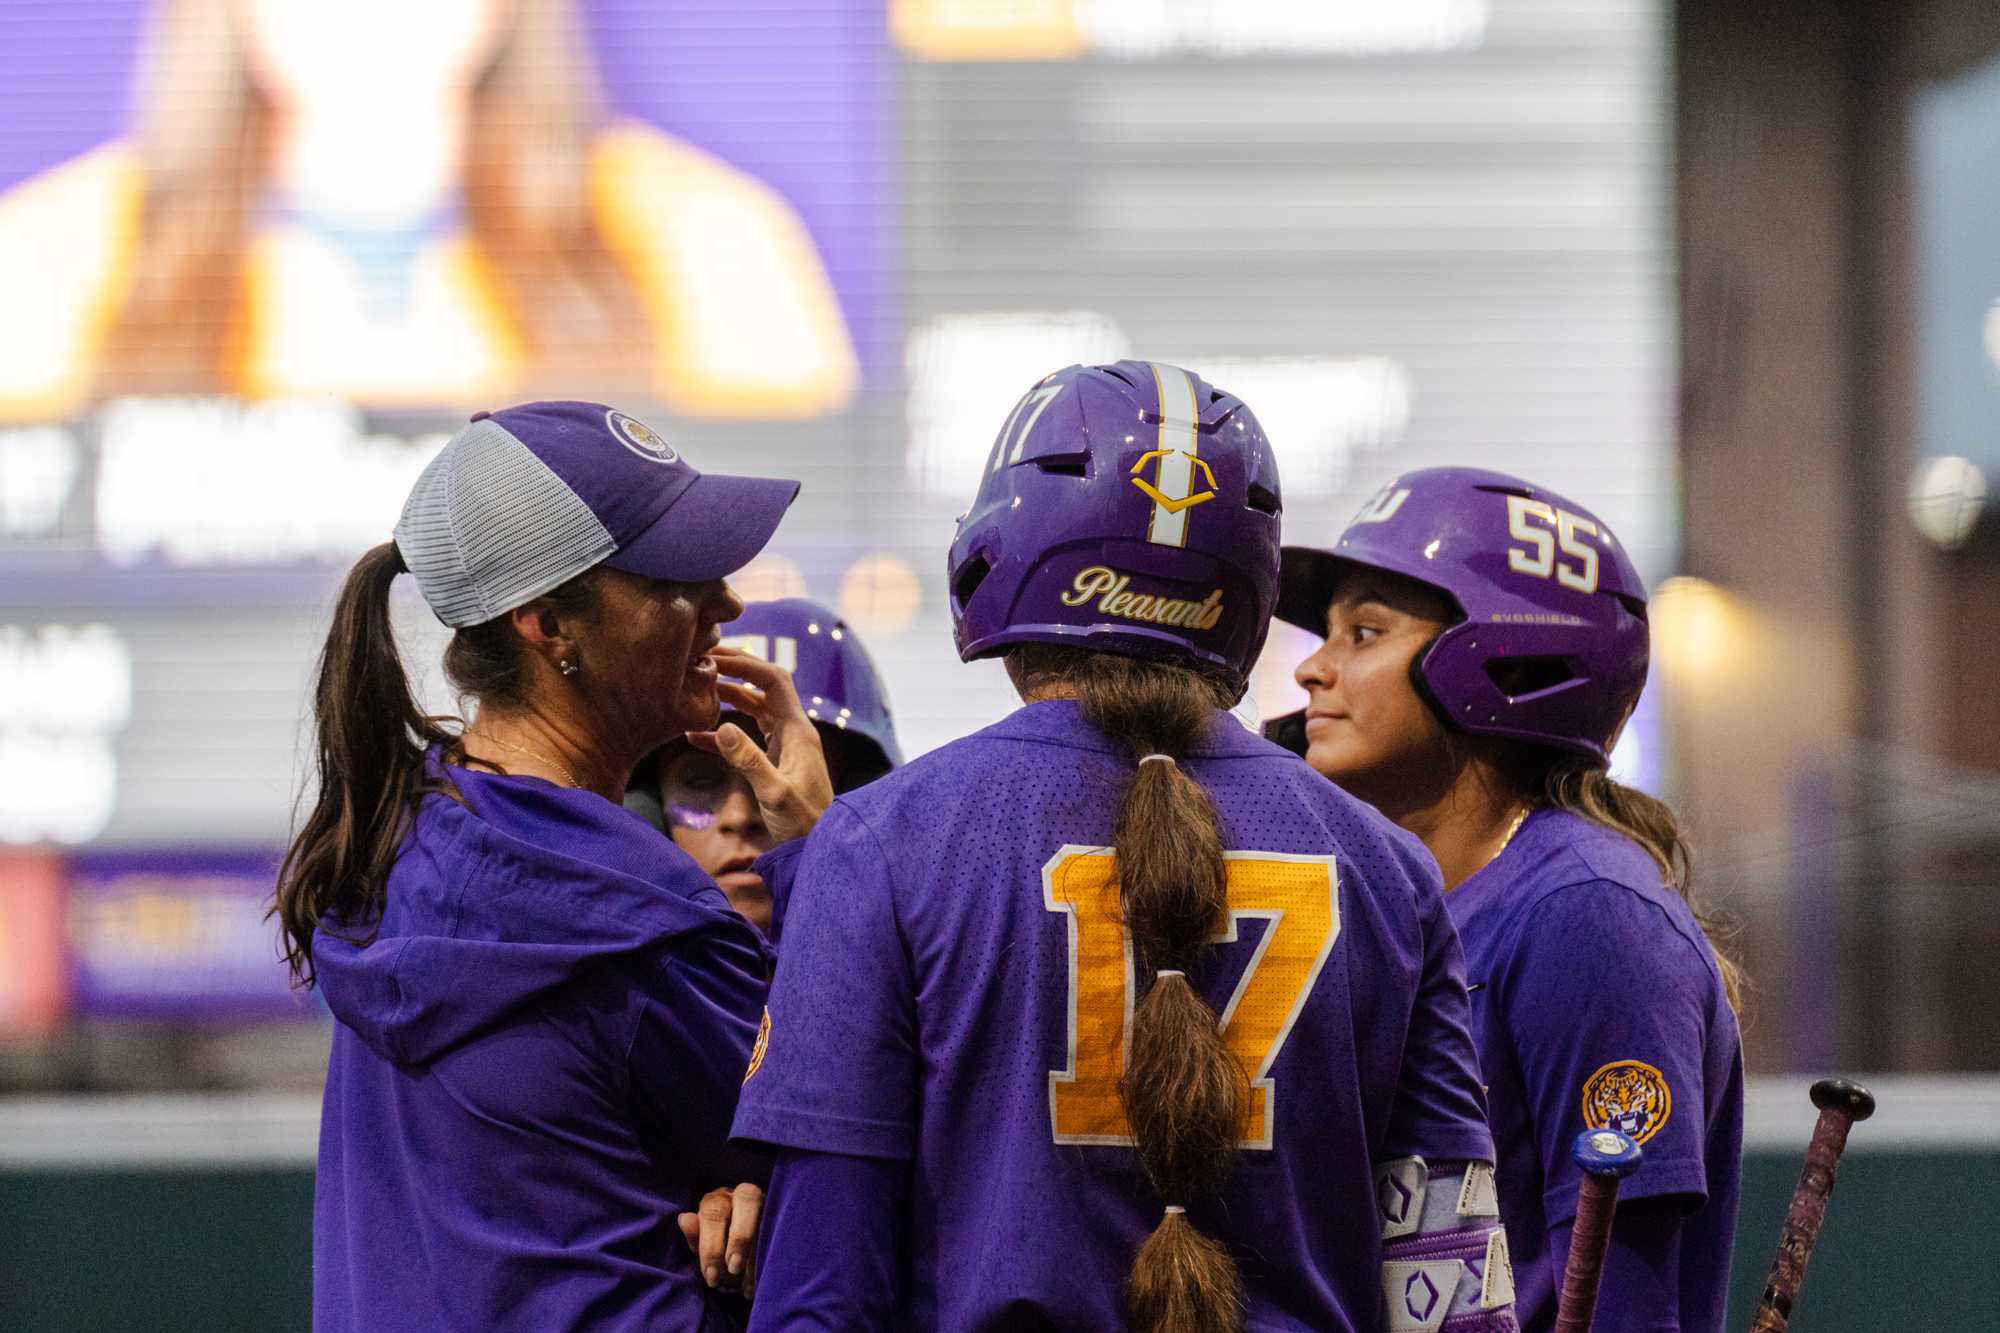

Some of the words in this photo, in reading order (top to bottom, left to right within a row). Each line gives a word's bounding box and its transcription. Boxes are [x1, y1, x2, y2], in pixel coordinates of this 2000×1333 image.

[993, 384, 1064, 472] 17
[1507, 495, 1598, 594] 55
[1492, 613, 1581, 626] EVOSHIELD
[1042, 844, 1340, 1150] 17
